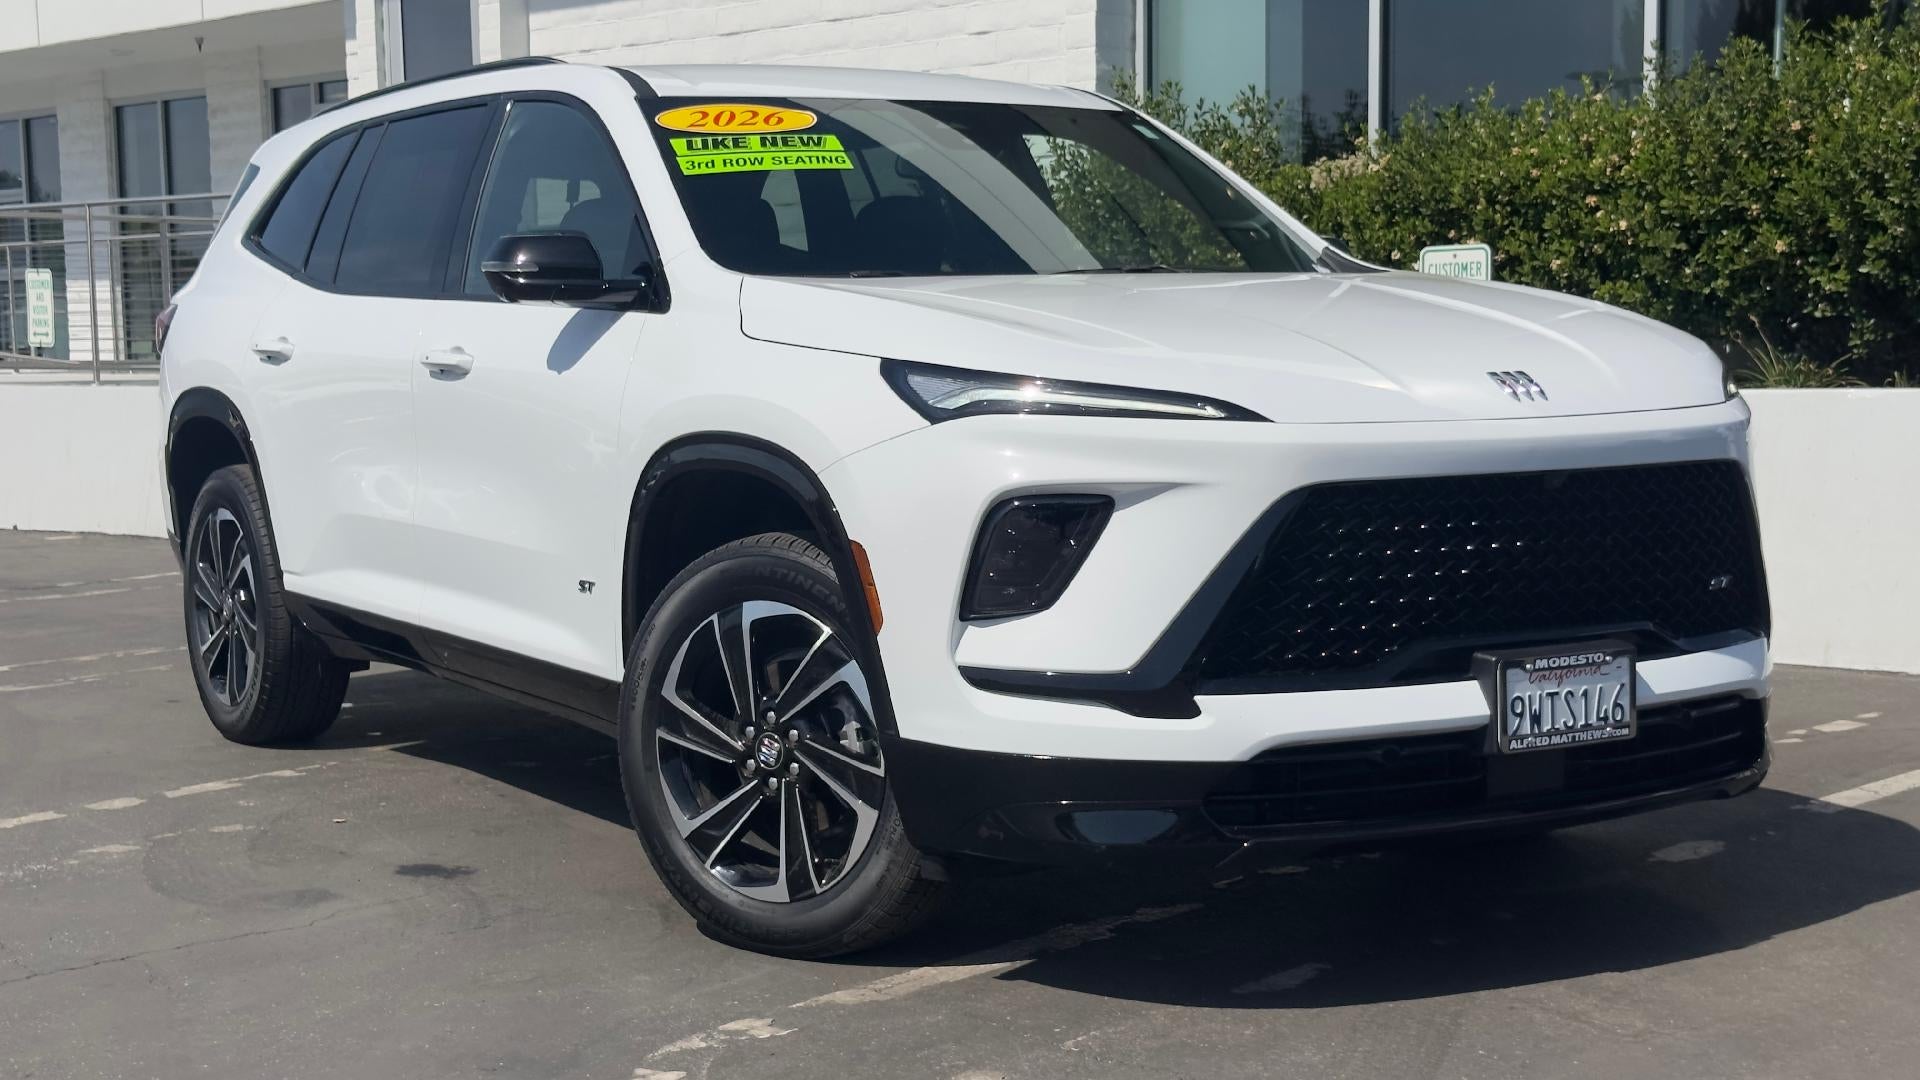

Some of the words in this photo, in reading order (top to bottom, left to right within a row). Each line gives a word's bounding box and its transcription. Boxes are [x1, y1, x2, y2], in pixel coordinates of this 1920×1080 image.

[687, 110, 785, 128] 2026
[685, 137, 749, 151] LIKE
[759, 135, 824, 149] NEW
[685, 159, 715, 170] 3rd
[722, 156, 764, 168] ROW
[770, 154, 846, 166] SEATING
[1428, 261, 1482, 278] CUSTOMER
[578, 580, 596, 594] ST
[1535, 653, 1604, 668] MODESTO
[1528, 666, 1609, 687] California
[1510, 683, 1625, 736] 9WIS146
